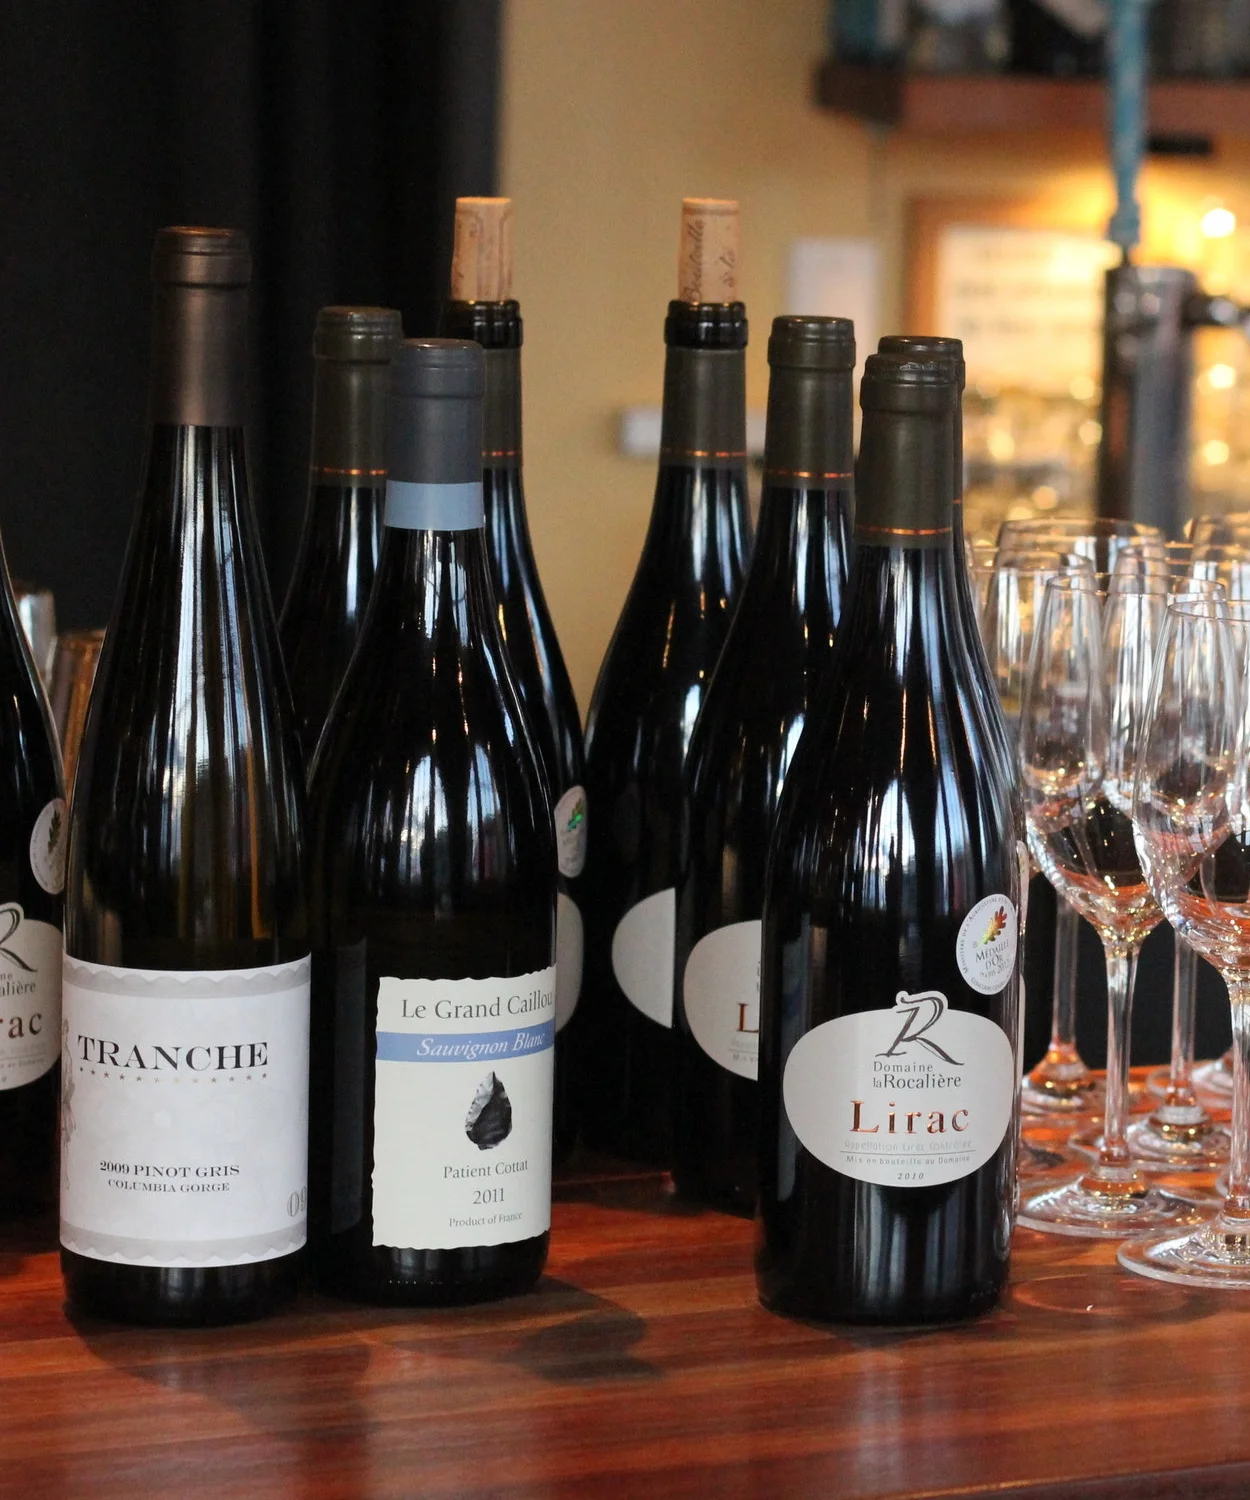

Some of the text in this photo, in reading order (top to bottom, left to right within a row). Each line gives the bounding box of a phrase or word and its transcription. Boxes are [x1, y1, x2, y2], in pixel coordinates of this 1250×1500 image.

[401, 998, 427, 1019] Le
[434, 997, 501, 1019] Grand
[78, 1035, 268, 1071] TRANCHE
[416, 1032, 546, 1060] Sauvignon Blanc
[873, 1061, 934, 1073] Domaine
[849, 1100, 970, 1134] Lirac
[938, 1155, 970, 1164] Domaine
[99, 1160, 241, 1179] 2009 PINOT GRIS
[443, 1159, 529, 1180] Patient Cottat
[897, 1172, 924, 1180] 2010
[107, 1178, 230, 1193] COLUMBIA GORGE
[471, 1187, 505, 1205] 2011
[448, 1210, 523, 1228] Product of France
